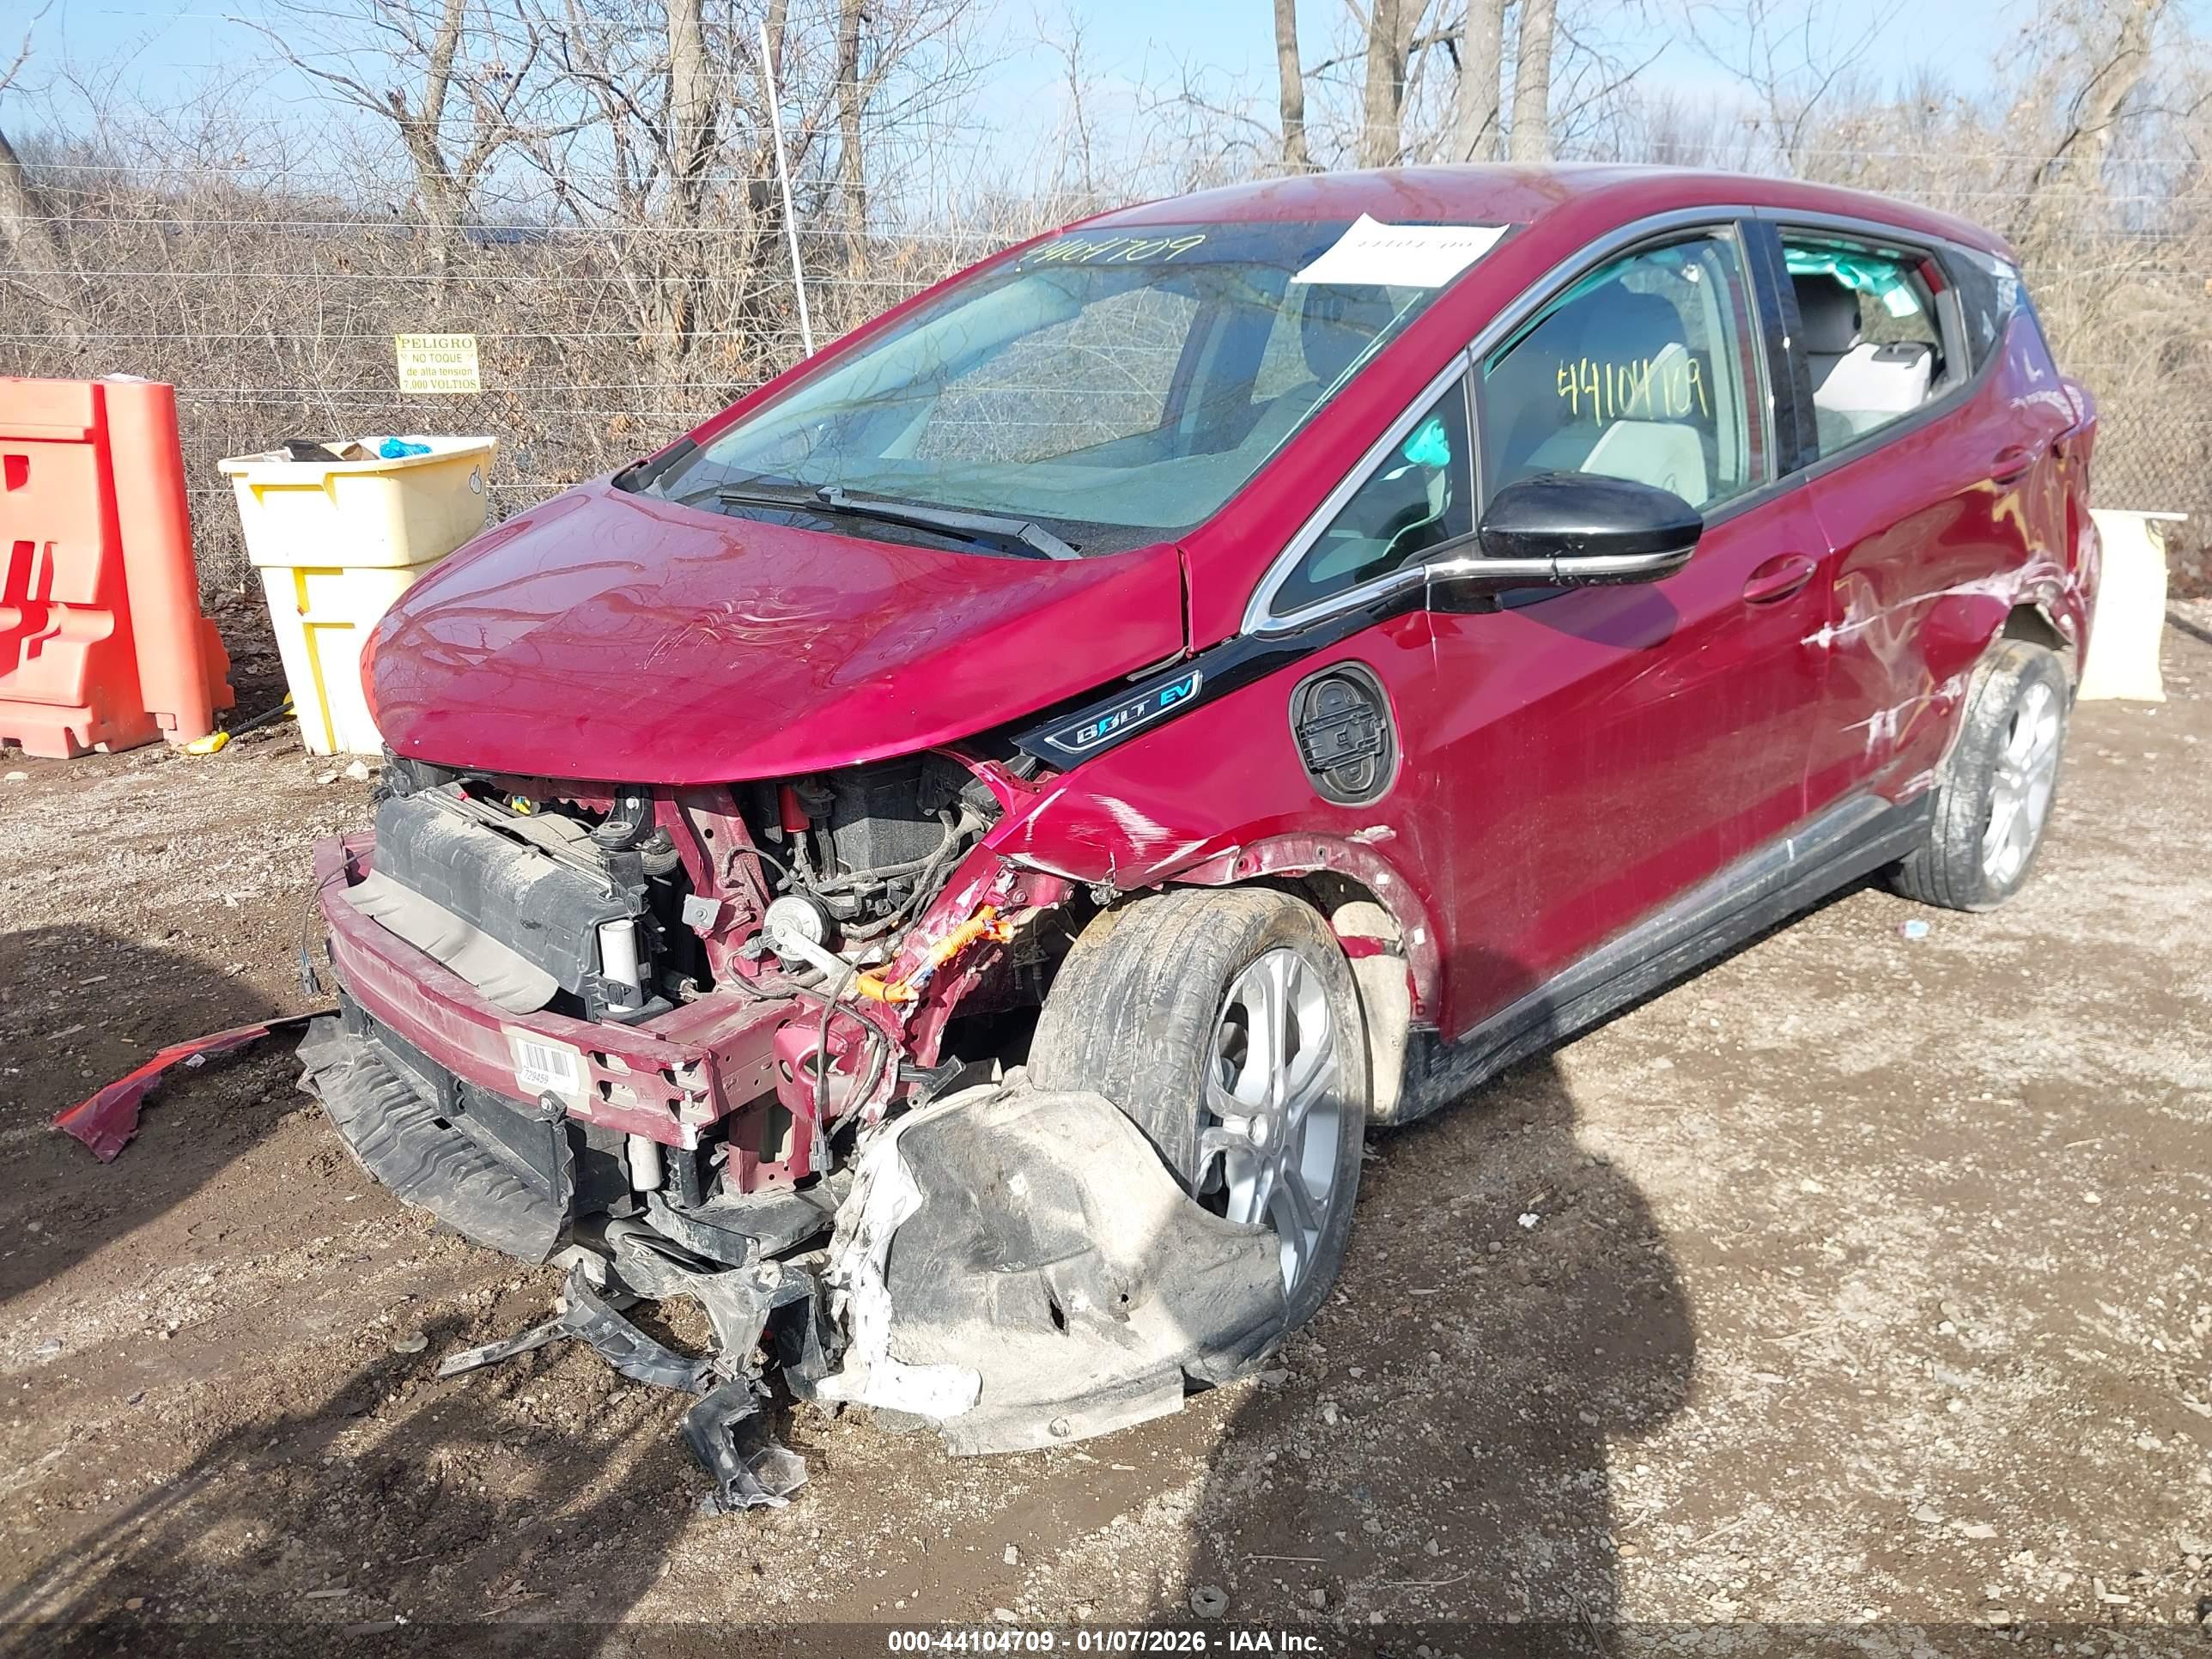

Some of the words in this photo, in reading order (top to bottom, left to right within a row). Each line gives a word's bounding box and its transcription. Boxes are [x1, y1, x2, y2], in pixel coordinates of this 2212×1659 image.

[400, 337, 473, 349] PELIGRO
[412, 353, 427, 363] NO
[429, 353, 463, 363] TOQUE
[406, 367, 417, 376] de
[420, 367, 437, 376] alta
[439, 368, 473, 376] tension
[430, 380, 477, 389] VOLTIOS
[1077, 699, 1151, 744] BOLT
[1160, 679, 1192, 706] EV
